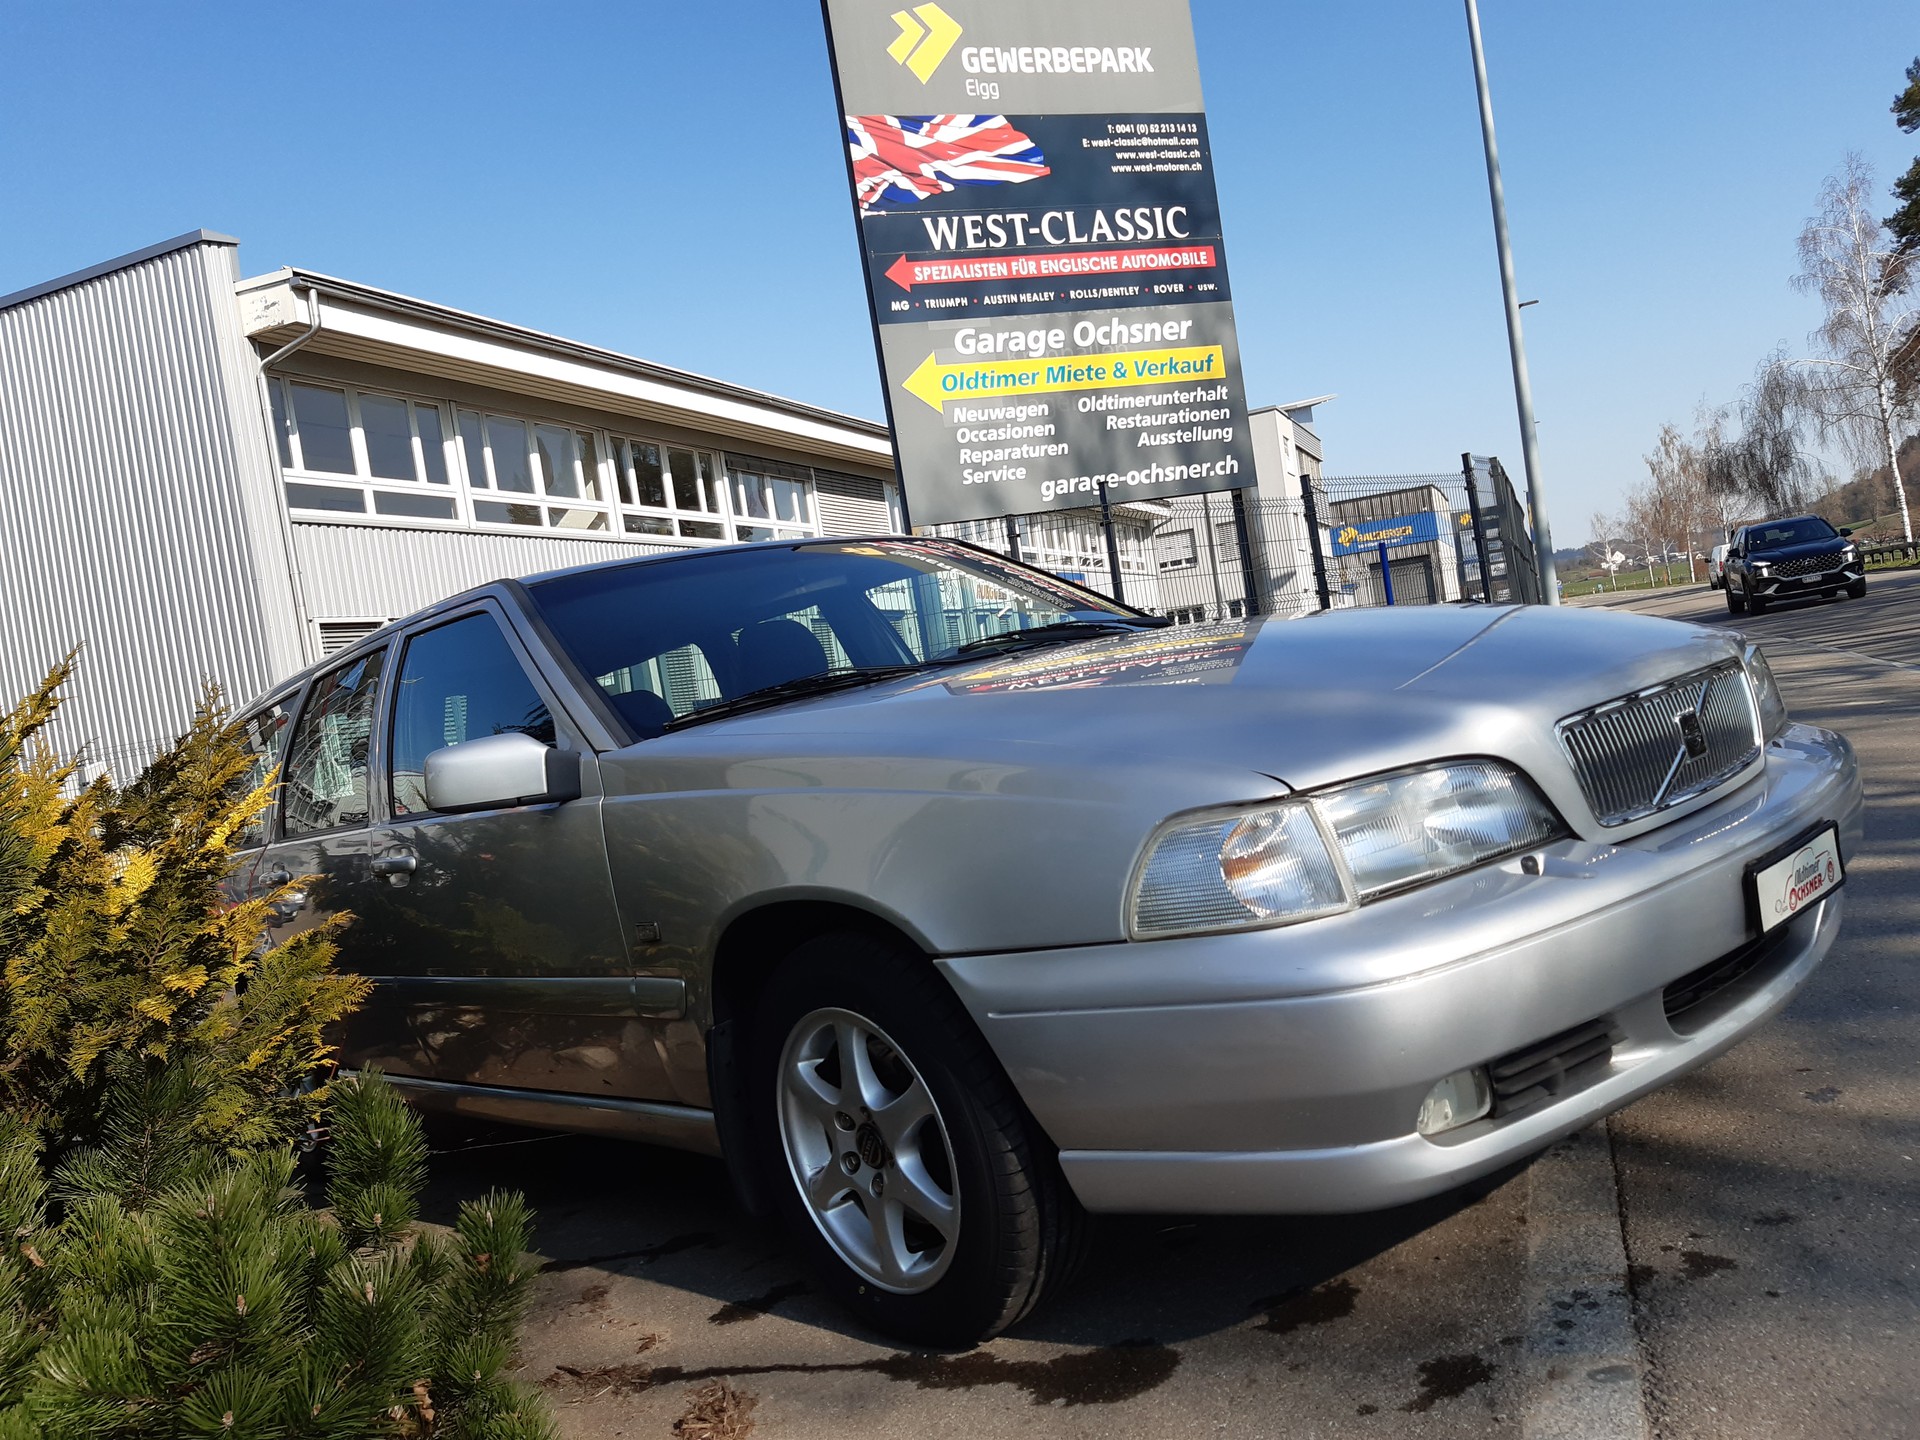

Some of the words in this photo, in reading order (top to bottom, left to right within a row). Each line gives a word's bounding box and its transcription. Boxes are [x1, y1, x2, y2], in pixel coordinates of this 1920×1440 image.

[961, 47, 1155, 73] GEWERBEPARK
[965, 78, 1000, 100] Elgg
[1107, 124, 1114, 134] T:
[1115, 124, 1135, 134] 0041
[1136, 124, 1149, 135] (0)
[1149, 123, 1160, 133] 52
[1160, 123, 1175, 133] 213
[1176, 123, 1187, 133] 14
[1188, 123, 1197, 133] 13
[1082, 138, 1090, 147] E:
[1091, 136, 1199, 147] west-classic@hotmail.com
[1115, 149, 1201, 160] www.west-classic.ch
[1111, 162, 1202, 173] www.west-motoren.ch
[922, 206, 1191, 251] WEST-CLASSIC
[914, 262, 1008, 281] SPEZIALISTEN
[1011, 258, 1037, 275] FÜR
[1040, 256, 1118, 274] ENGLISCHE
[1121, 251, 1208, 269] AUTOMOBILE
[891, 301, 910, 311] MG
[924, 297, 968, 309] TRIUMPH
[983, 294, 1019, 305] AUSTIN
[1020, 291, 1055, 303] HEALEY
[1069, 286, 1140, 300] ROLLS/BENTLEY
[1153, 283, 1185, 294] ROVER
[954, 328, 1066, 358] Garage
[1073, 317, 1193, 347] Ochsner
[941, 370, 1040, 392] Oldtimer
[1046, 364, 1107, 384] Miete
[1113, 361, 1128, 379] &
[1133, 353, 1214, 377] Verkauf
[1078, 385, 1229, 413] Oldtimerunterhalt
[953, 403, 1049, 424] Neuwagen
[1106, 407, 1231, 430] Restaurationen
[957, 423, 1056, 444] Occasionen
[1137, 426, 1233, 447] Ausstellung
[959, 443, 1069, 467] Reparaturen
[962, 465, 1027, 485] Service
[1040, 454, 1239, 502] garage-ochsner.ch
[1789, 872, 1823, 912] OCHSNER
